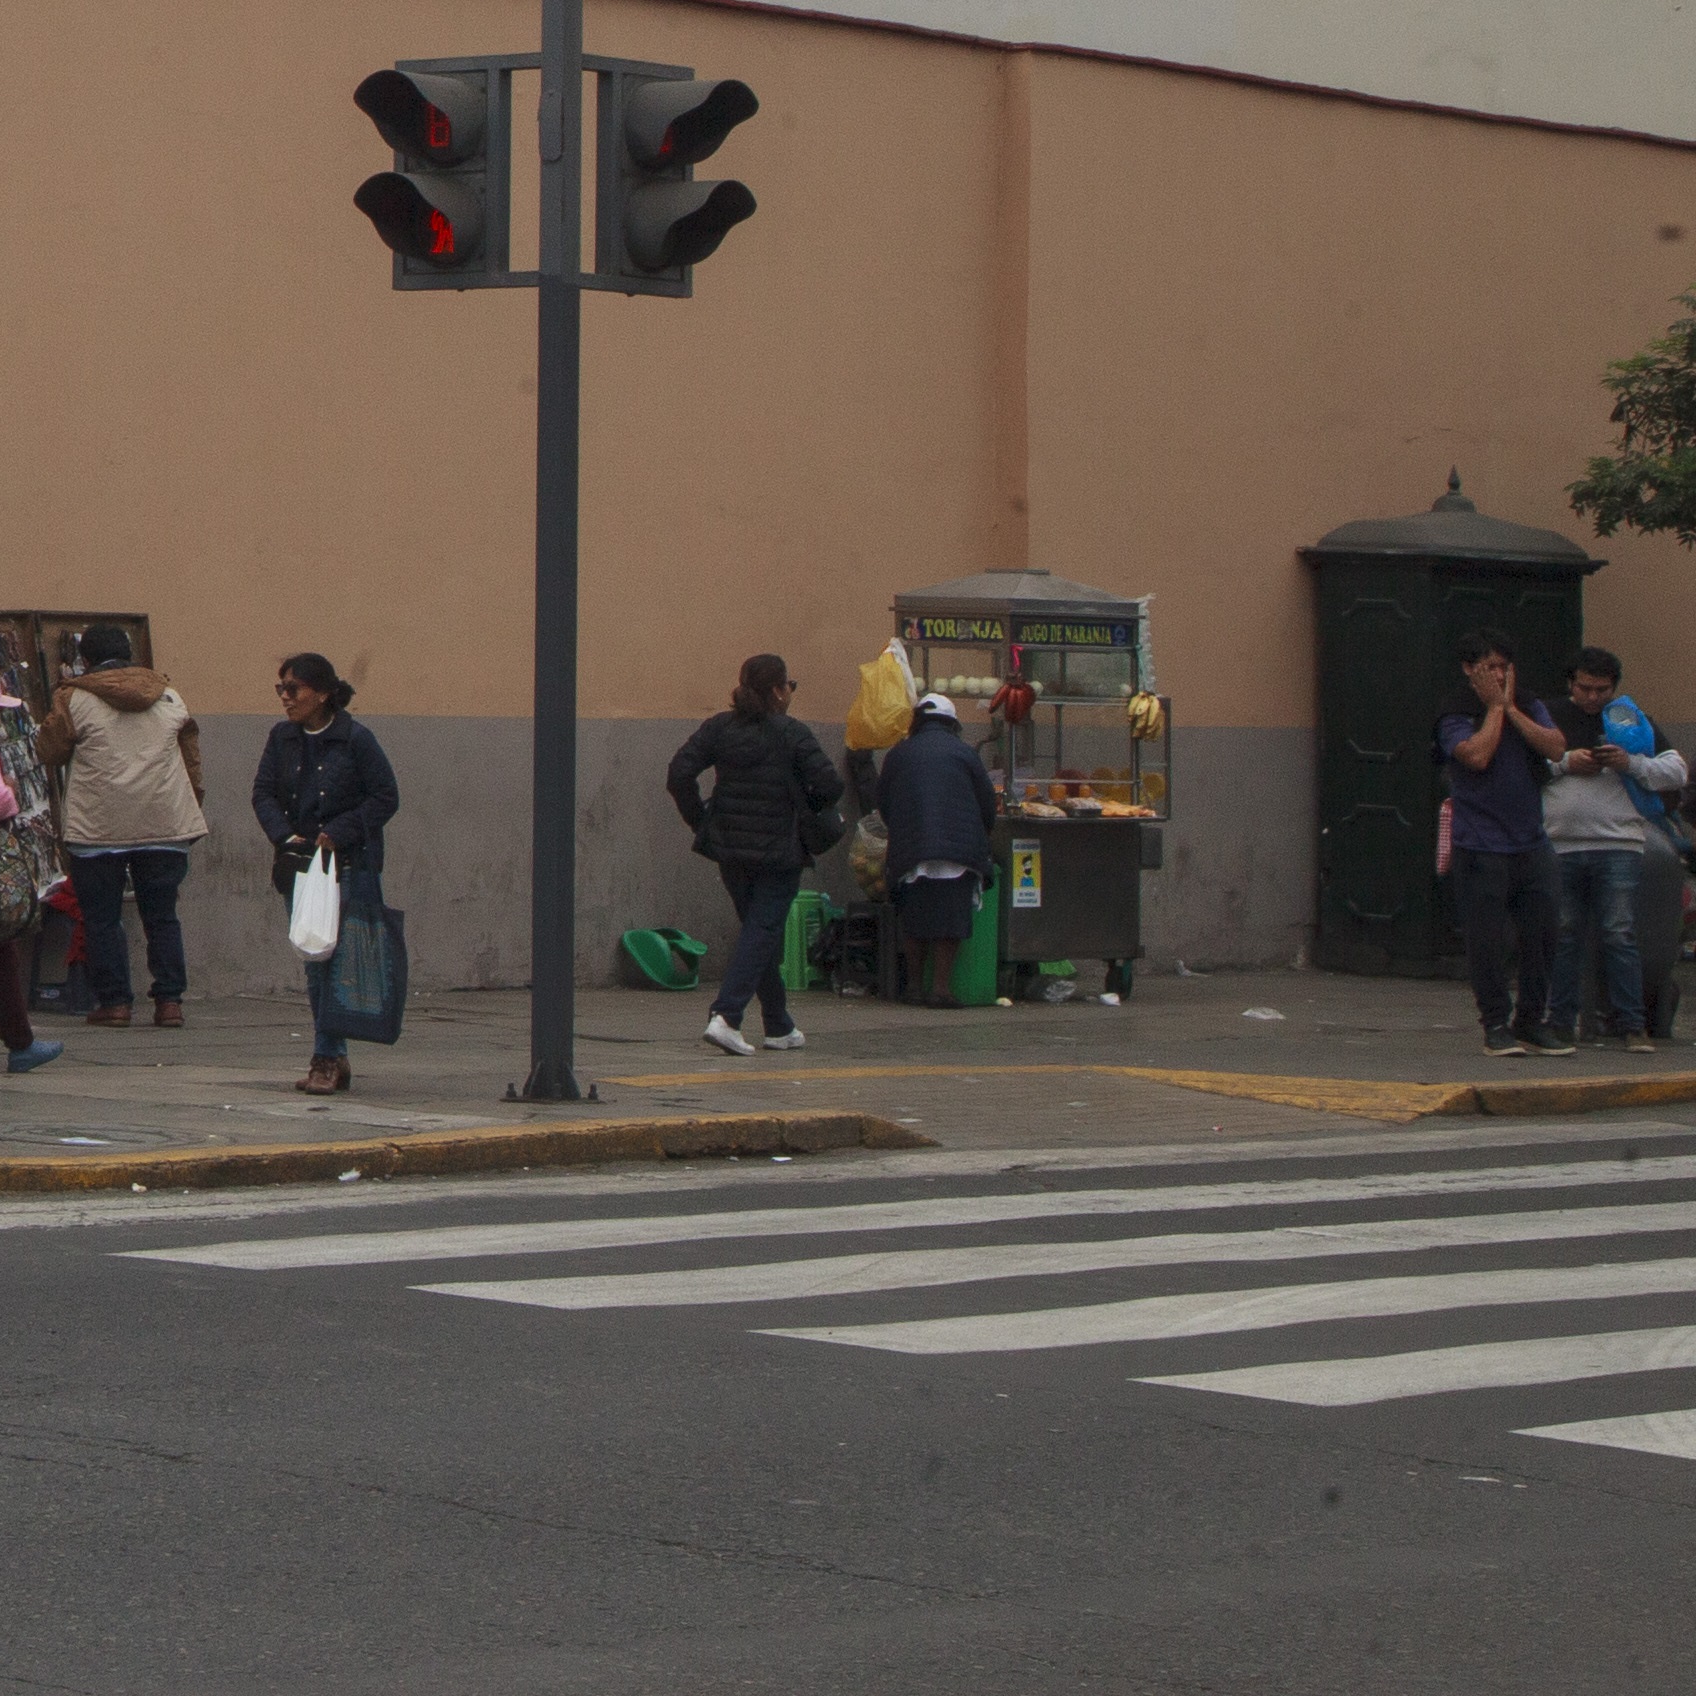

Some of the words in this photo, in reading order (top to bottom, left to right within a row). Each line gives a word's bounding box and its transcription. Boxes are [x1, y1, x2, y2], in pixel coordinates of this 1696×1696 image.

[923, 619, 1003, 639] TORNJA
[1020, 624, 1048, 642] JUGO
[1050, 624, 1064, 642] DE
[1065, 624, 1112, 644] NARANJA
